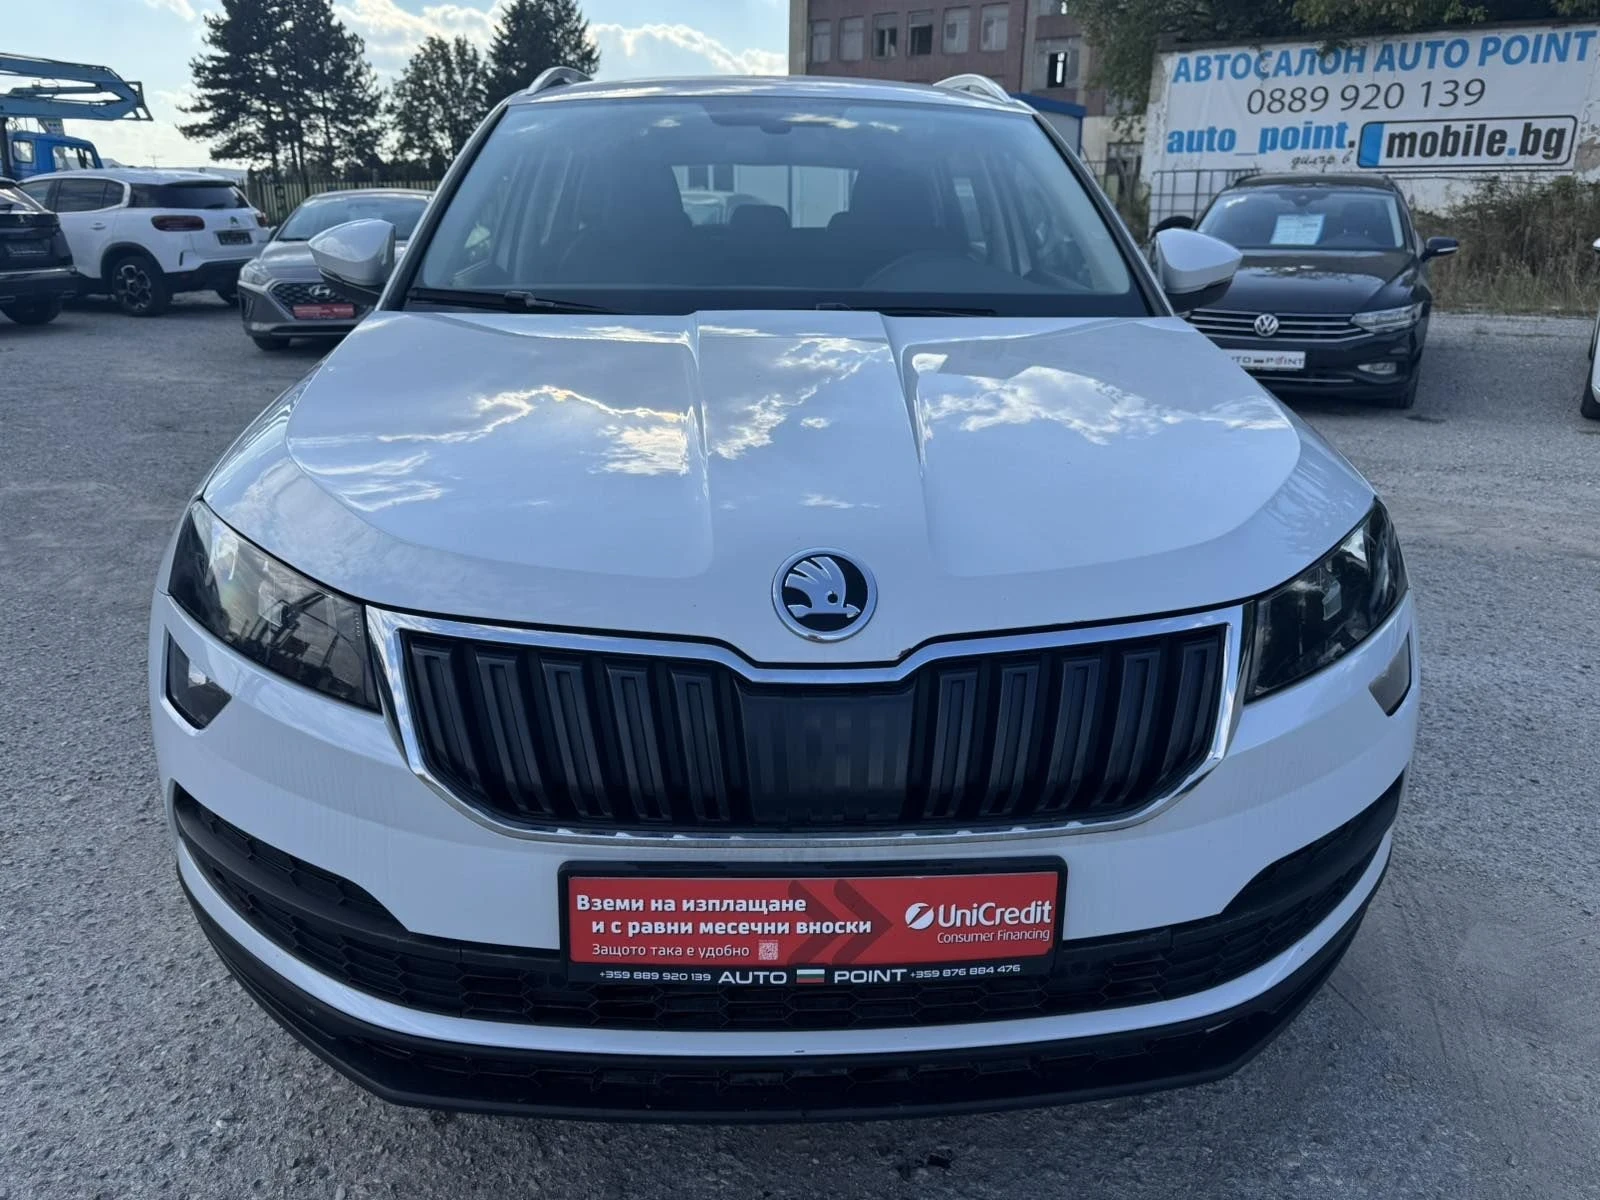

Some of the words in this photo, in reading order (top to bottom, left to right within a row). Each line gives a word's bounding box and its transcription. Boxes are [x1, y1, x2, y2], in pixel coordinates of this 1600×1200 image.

[1172, 46, 1365, 84] АВТОСАЛОН
[1374, 38, 1470, 73] AUTO
[1478, 29, 1597, 67] POINT
[1247, 85, 1329, 115] 0889
[1340, 82, 1405, 111] 920
[1421, 78, 1486, 108] 139
[1386, 121, 1568, 161] mobile.bg
[576, 894, 644, 912] Вземи
[650, 898, 676, 912] на
[682, 898, 807, 914] изплащане
[938, 900, 1053, 928] UniCredit
[592, 921, 605, 934] и
[611, 921, 621, 934] с
[628, 921, 693, 937] равни
[699, 921, 789, 935] месечни
[796, 921, 872, 935] вноски
[937, 930, 995, 944] Consumer
[997, 929, 1050, 943] Financing
[592, 943, 646, 958] Защото
[650, 945, 683, 957] така
[686, 946, 695, 957] е
[698, 945, 750, 959] удобно
[599, 970, 631, 980] +359
[633, 971, 660, 981] 889
[662, 972, 688, 981] 920
[691, 972, 712, 982] 139
[718, 971, 788, 985] AUTO
[834, 968, 907, 984] POINT
[909, 969, 940, 979] +359
[942, 967, 967, 977] 876
[970, 966, 995, 976] 884
